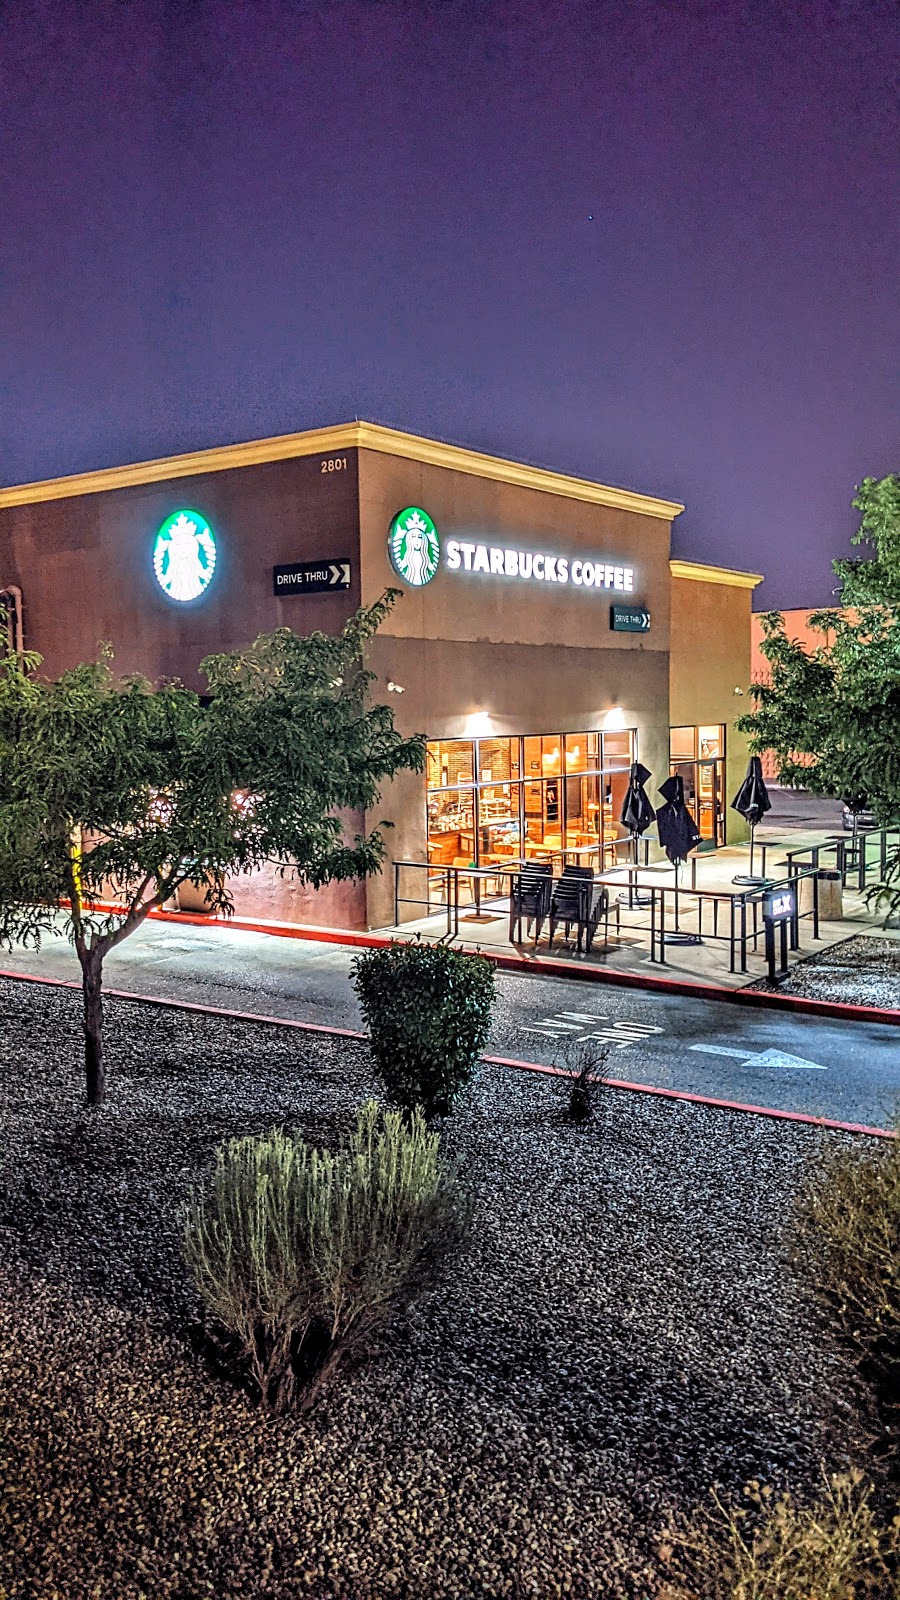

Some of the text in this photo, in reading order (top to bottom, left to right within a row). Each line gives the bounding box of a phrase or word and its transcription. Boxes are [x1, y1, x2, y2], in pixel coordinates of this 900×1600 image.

[321, 458, 347, 473] 2801
[446, 540, 634, 592] STARBUCKS COFFEE
[276, 570, 328, 585] DRIVE THRU
[615, 614, 641, 624] DRIVE THRU
